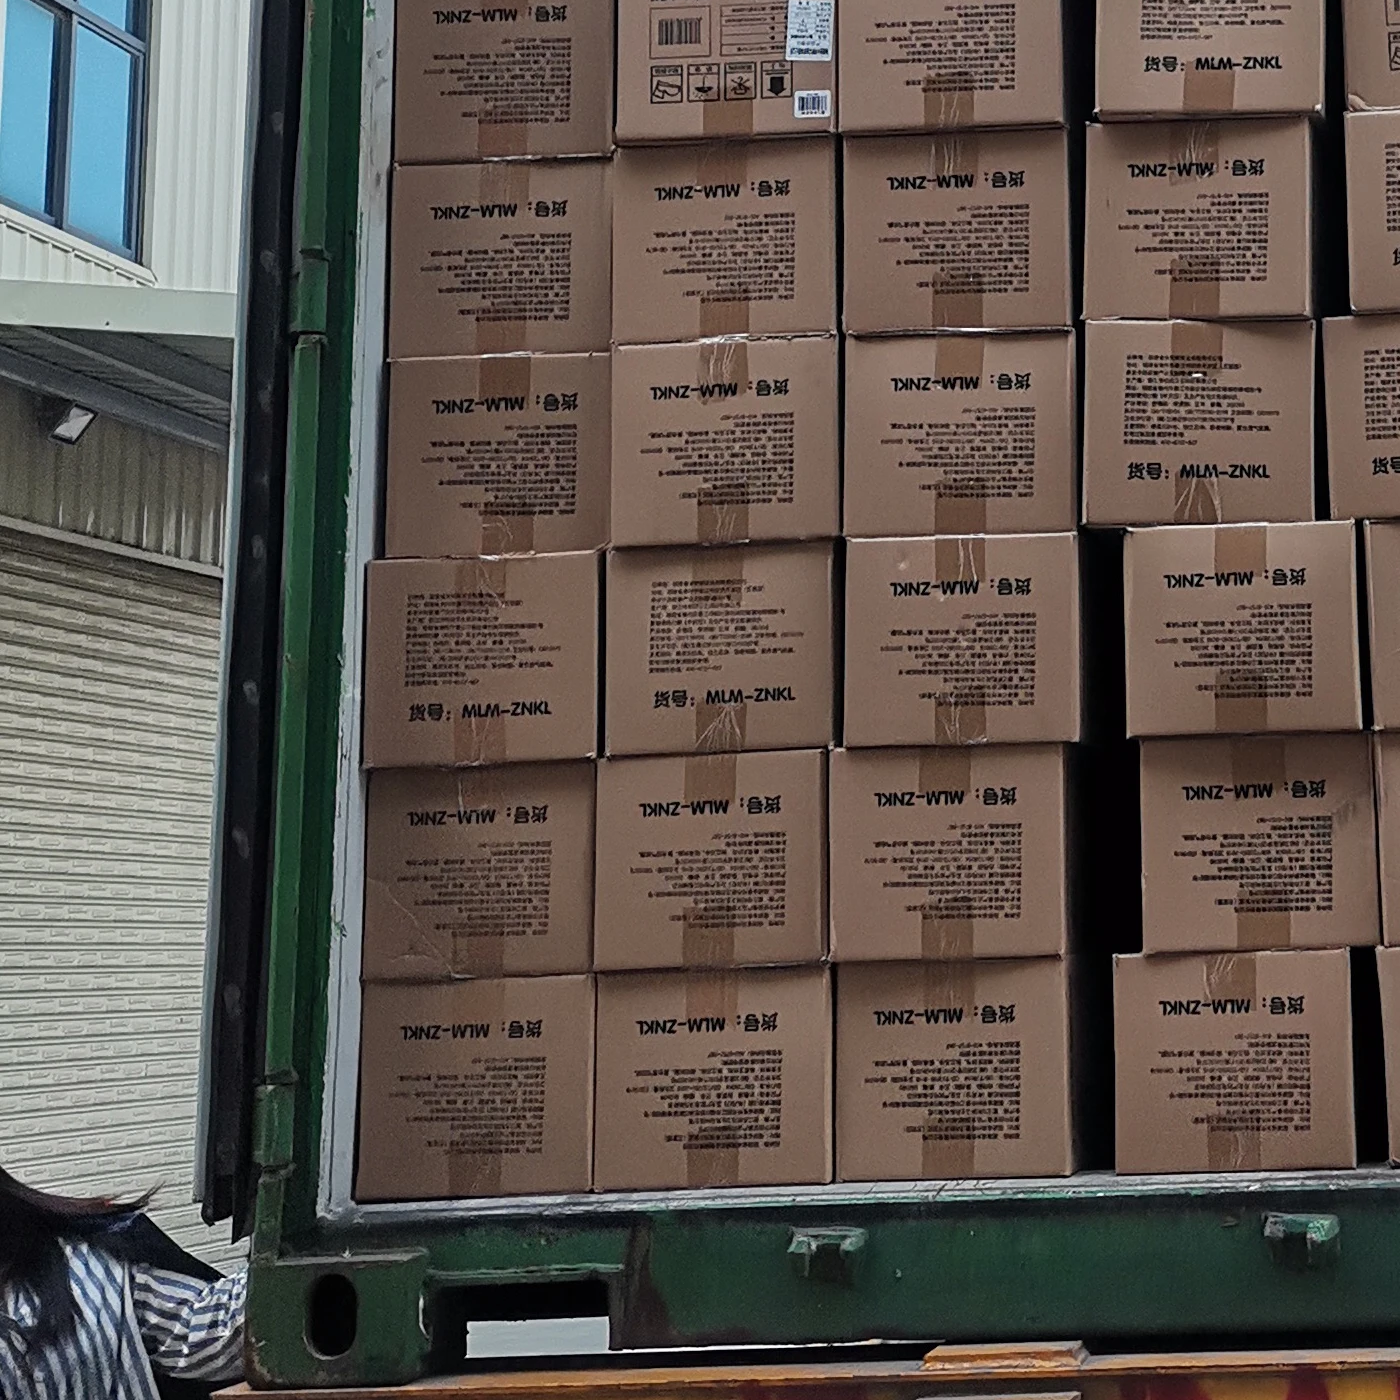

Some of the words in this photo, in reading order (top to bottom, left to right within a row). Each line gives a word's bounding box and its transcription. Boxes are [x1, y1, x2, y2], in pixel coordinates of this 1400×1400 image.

[432, 7, 518, 25] MLM-ZNKL
[1194, 55, 1283, 71] MLM-ZNKL
[1126, 160, 1215, 179] MLM-ZNKL
[885, 173, 975, 191] MLM-ZNKL
[653, 183, 741, 202] MLM-ZNKL
[429, 202, 518, 221] MLM-ZNKL
[649, 382, 738, 399] MLM-ZNKL
[889, 375, 980, 393] MLM-ZNKL
[431, 395, 526, 415] MLM-ZNKL
[1179, 463, 1271, 480] MLM-ZNKL
[889, 579, 980, 598] MLM-ZNKL
[1162, 569, 1255, 590] MLM-ZNKL
[705, 685, 797, 706] MLM-ZNKL
[461, 700, 553, 720] MLM-ZNKL
[873, 789, 965, 808] MLM-ZNKL
[1181, 782, 1274, 802] MLM-ZNKL
[406, 808, 497, 827] MLM-ZNKL
[638, 798, 730, 819] MLM-ZNKL
[1158, 995, 1252, 1017] MLM-ZNKL
[872, 1006, 964, 1026] MLM-ZNKL
[399, 1023, 491, 1042] MLM-ZNKL
[635, 1016, 726, 1036] MLM-ZNKL
